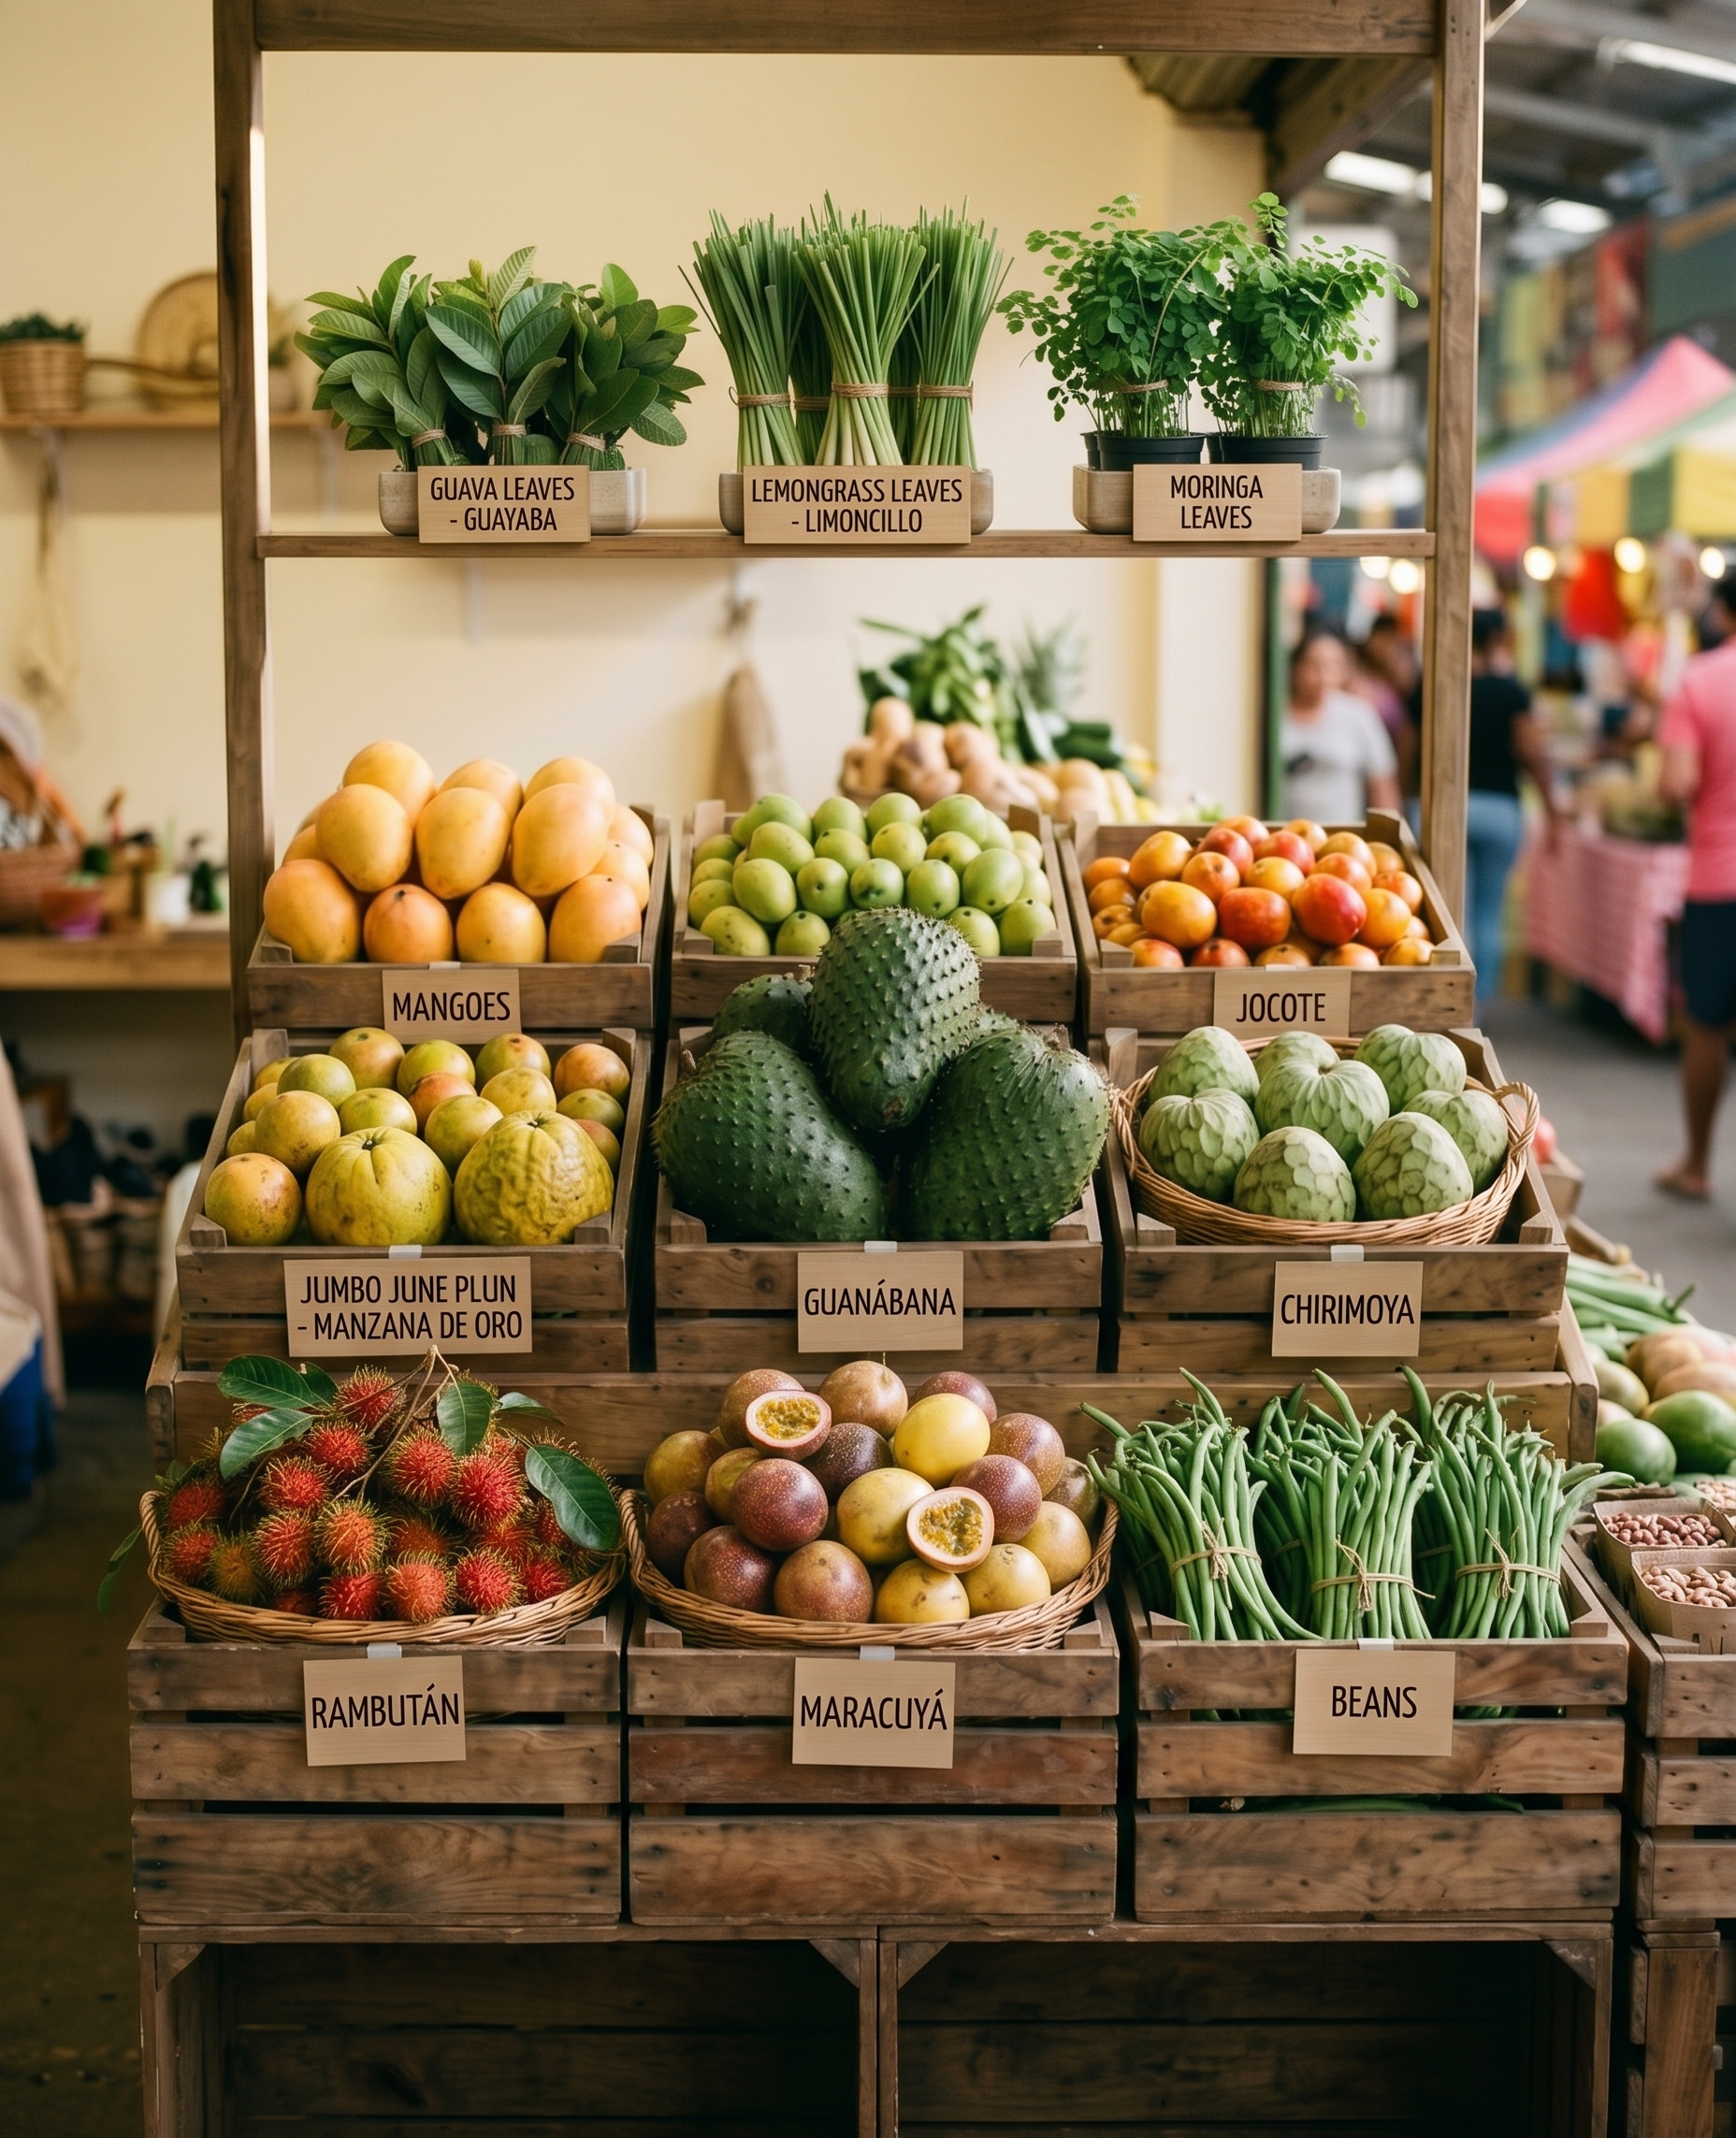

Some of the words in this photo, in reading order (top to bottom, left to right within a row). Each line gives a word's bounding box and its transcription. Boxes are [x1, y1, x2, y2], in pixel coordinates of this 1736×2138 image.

[430, 477, 499, 500] GUAVA
[503, 477, 575, 501] LEAVES
[752, 479, 885, 502] LEMONGRASS
[891, 479, 962, 502] LEAVES
[1170, 475, 1264, 499] MORINGA
[464, 507, 557, 531] GUAYABA
[805, 509, 923, 533] LIMONCILLO
[1181, 505, 1252, 529] LEAVES
[393, 991, 511, 1022] MANGOES
[1236, 992, 1326, 1022] JOCOTE
[299, 1275, 382, 1305] JUMBO
[387, 1275, 449, 1305] JUNE
[455, 1274, 516, 1304] PLUN
[804, 1278, 956, 1317] GUANÁBANA
[1280, 1293, 1415, 1325] CHIRIMOYA
[314, 1311, 434, 1340] MANZANA
[440, 1311, 469, 1339] DE
[474, 1310, 523, 1339] ORO
[311, 1683, 459, 1729] RAMBUTÁN
[801, 1687, 948, 1731] MARACUYÁ
[1332, 1685, 1417, 1719] BEANS
